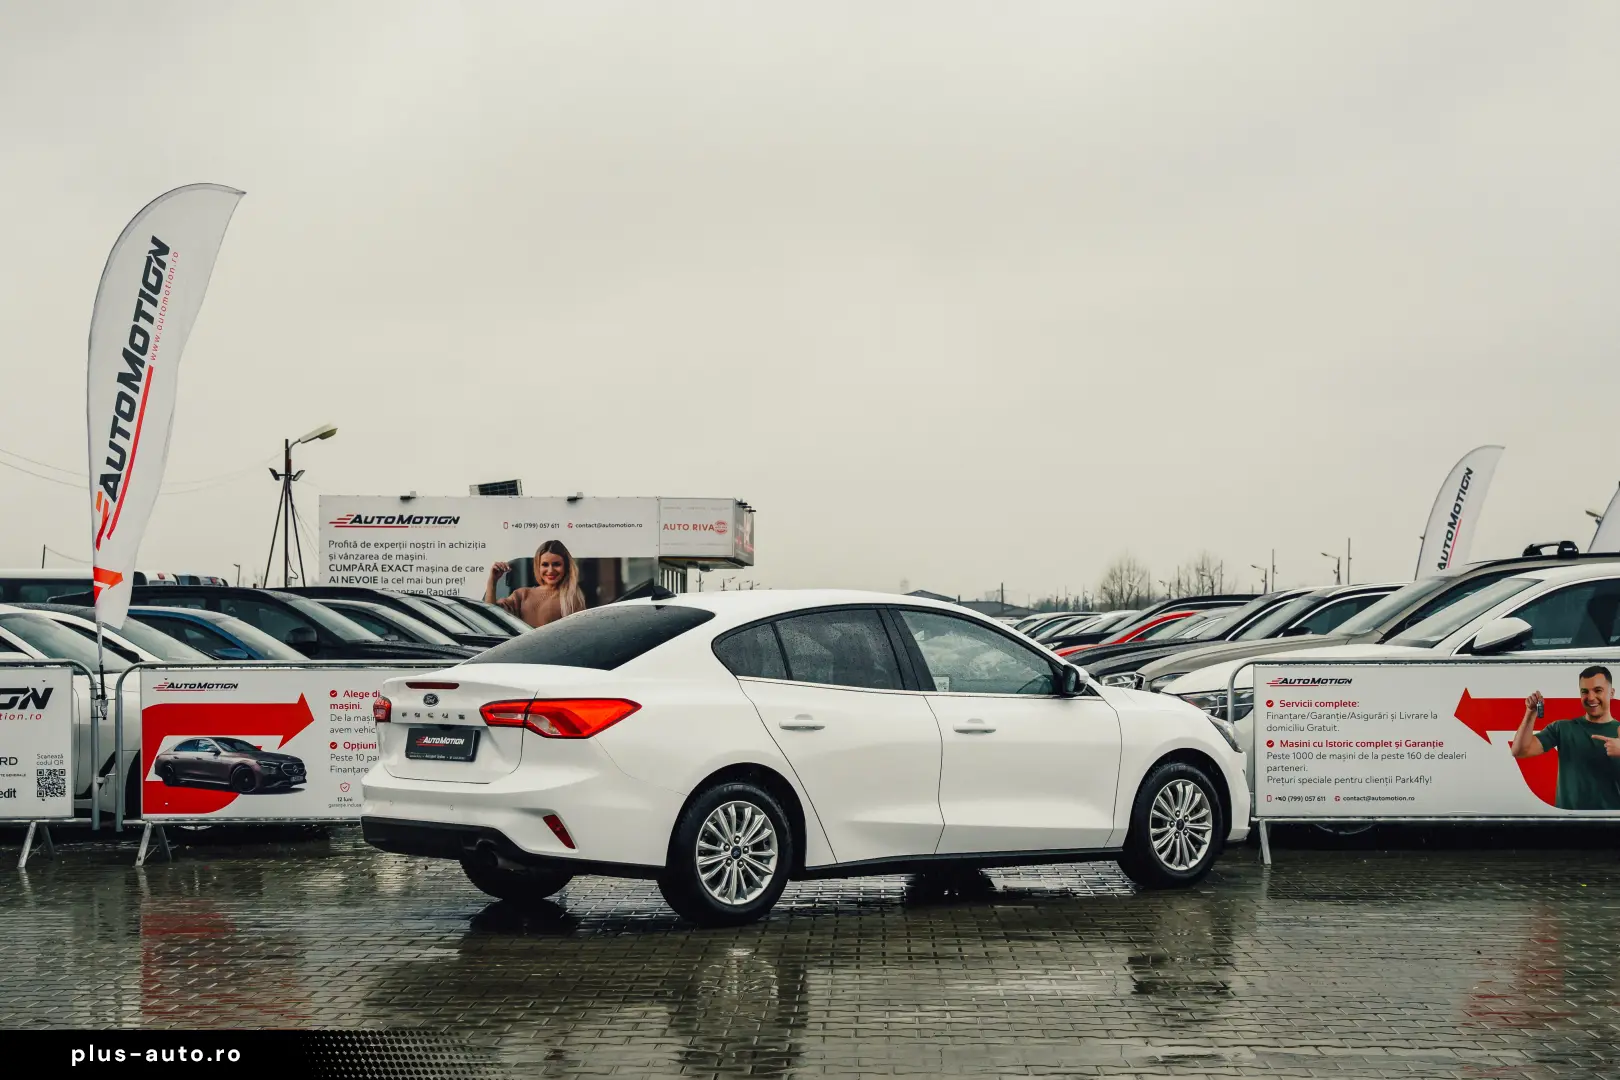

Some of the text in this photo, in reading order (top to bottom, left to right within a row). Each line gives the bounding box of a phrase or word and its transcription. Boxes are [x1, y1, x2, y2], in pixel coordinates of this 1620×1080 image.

[150, 250, 179, 361] www.automotion.ro
[99, 235, 171, 504] AUTOMOTION
[350, 514, 460, 525] AUTOMOTION
[1437, 467, 1473, 570] AUTOMOTION
[663, 523, 689, 531] AUTO
[692, 523, 715, 531] RIVA
[329, 540, 357, 548] Profită
[338, 552, 379, 560] vânzarea
[381, 564, 414, 572] EXACT
[341, 576, 378, 584] NEVOIE
[381, 576, 388, 584] la
[391, 576, 404, 584] cel
[407, 576, 423, 584] mai
[426, 576, 443, 584] bun
[1279, 677, 1353, 685] AUTOMOTION
[343, 689, 381, 699] Alege di
[1315, 700, 1359, 709] complete:
[0, 712, 42, 721] tion.ro
[330, 714, 342, 722] De
[344, 714, 351, 722] la
[1431, 711, 1437, 719] la
[422, 736, 465, 745] AUTOMOTION
[1356, 740, 1392, 749] complet
[0, 757, 18, 765] RD
[1292, 752, 1313, 760] 1000
[1381, 753, 1404, 761] peste
[1267, 764, 1307, 773] parteneri.
[1298, 776, 1332, 785] speciale
[1335, 777, 1362, 785] pentru
[1396, 775, 1432, 785] Park4fly!
[0, 788, 17, 798] edit
